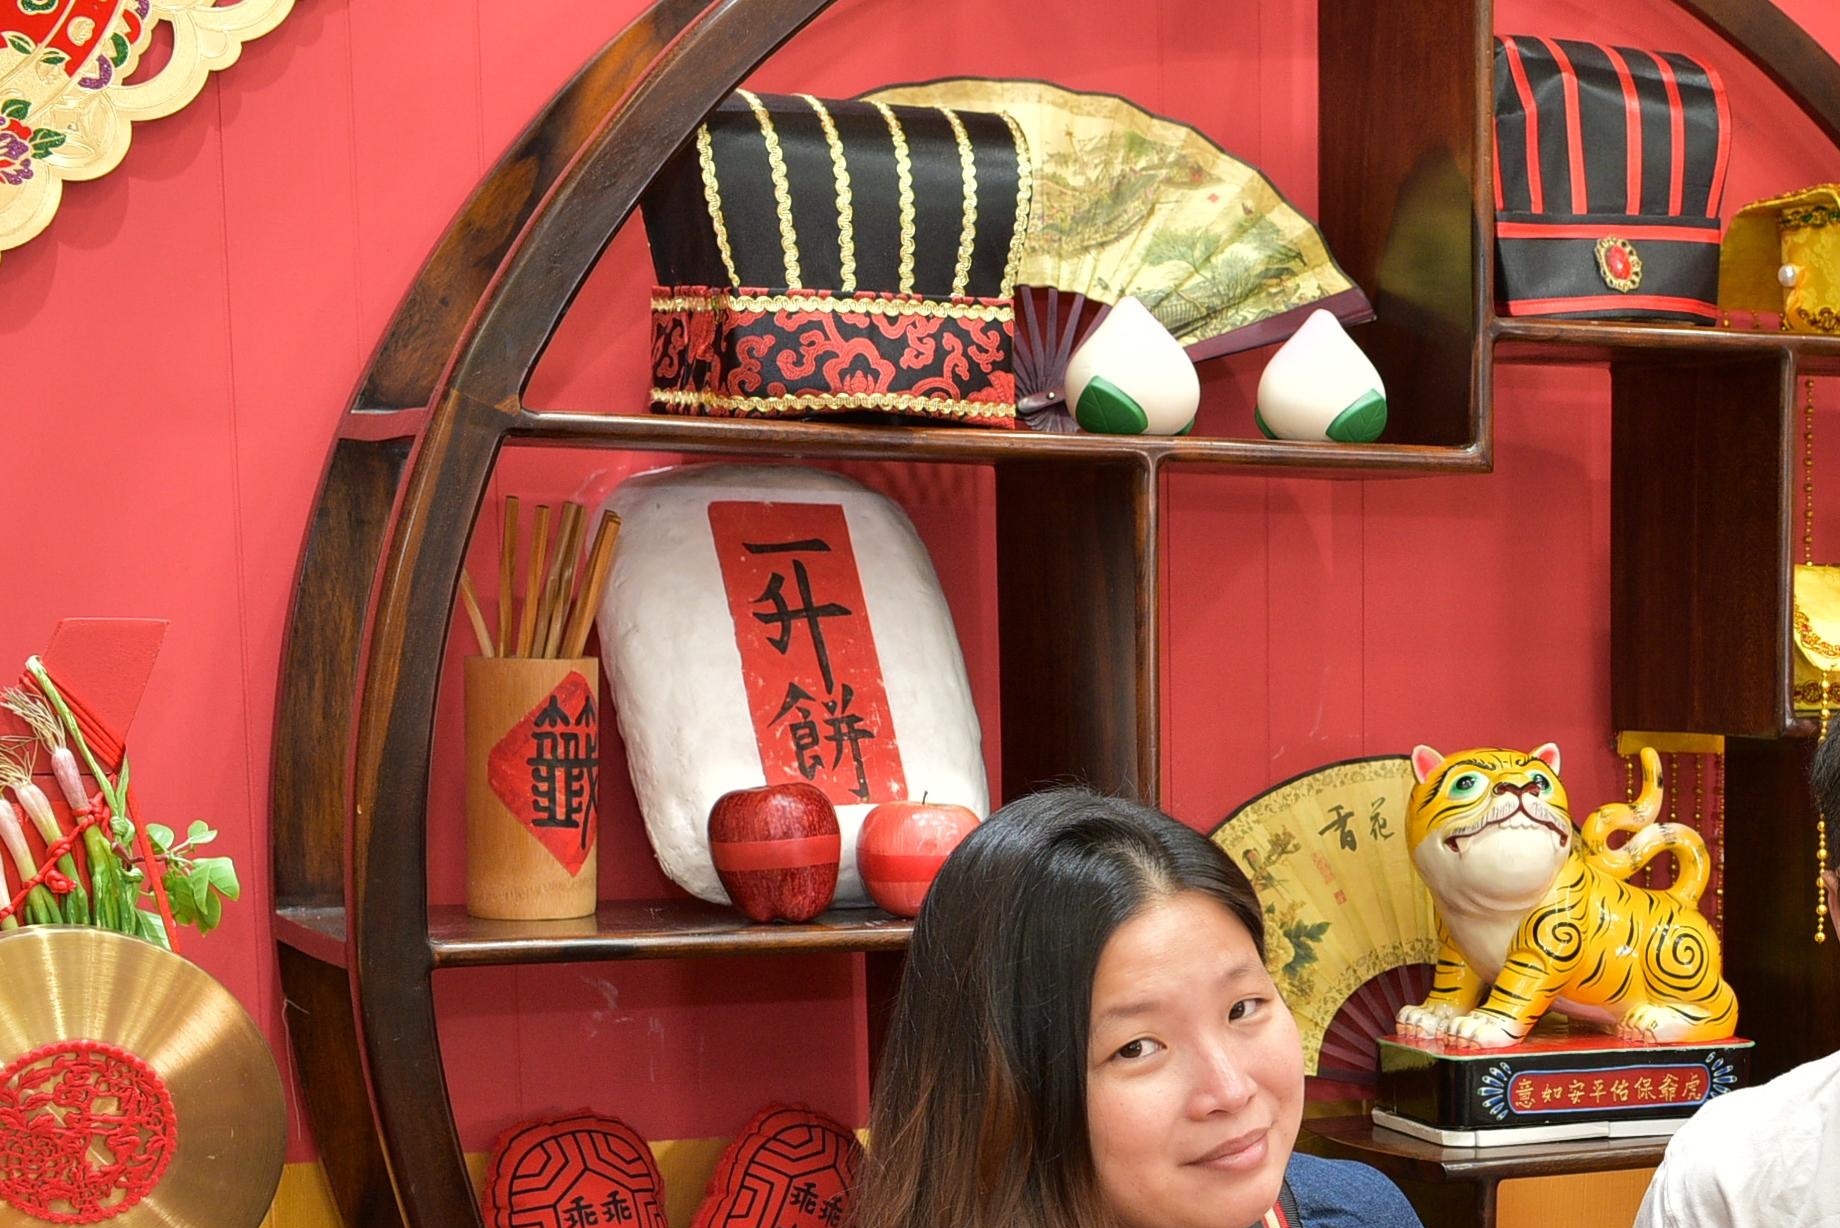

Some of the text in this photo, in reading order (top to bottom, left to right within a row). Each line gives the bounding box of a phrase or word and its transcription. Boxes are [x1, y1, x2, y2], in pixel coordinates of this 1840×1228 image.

[742, 538, 875, 799] 一升餅
[789, 1182, 843, 1228] 乖乖
